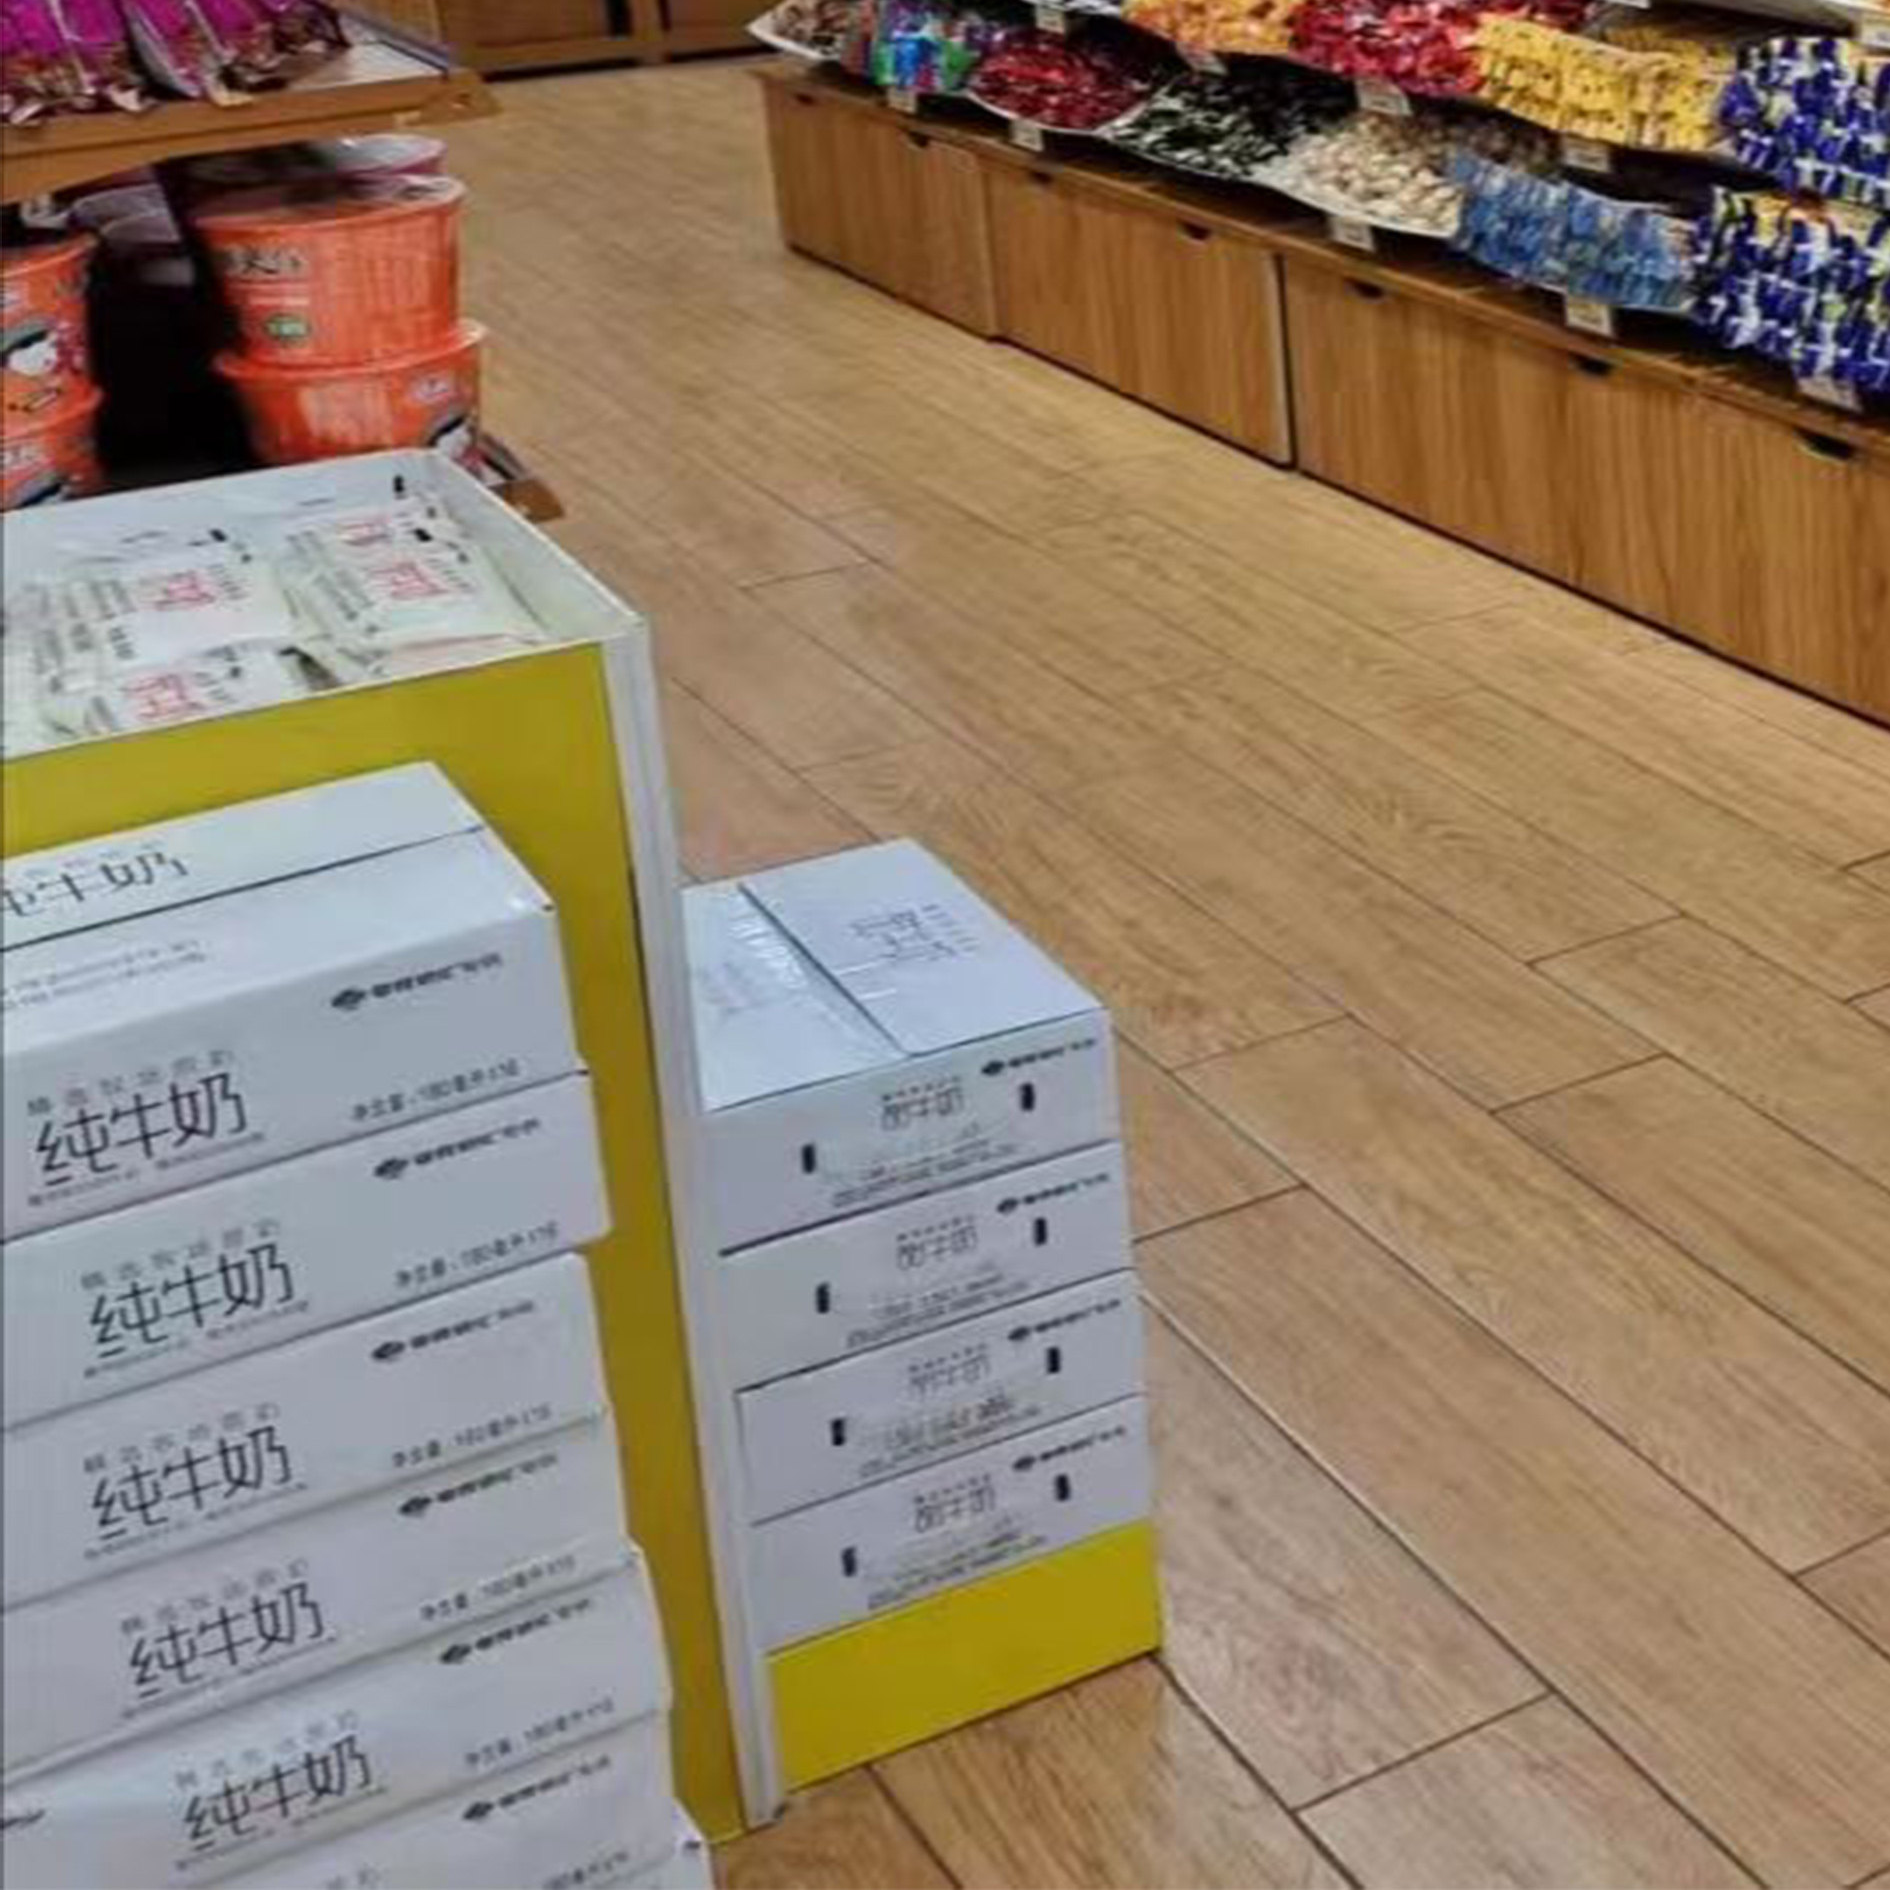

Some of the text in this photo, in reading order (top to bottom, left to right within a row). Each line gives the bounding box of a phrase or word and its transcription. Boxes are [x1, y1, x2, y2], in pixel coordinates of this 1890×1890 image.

[36, 1071, 248, 1186] 纯牛奶
[89, 1242, 296, 1360] 纯牛奶
[90, 1424, 294, 1541] 纯牛奶
[128, 1580, 327, 1699] 纯牛奶
[182, 1733, 374, 1852] 纯牛奶
